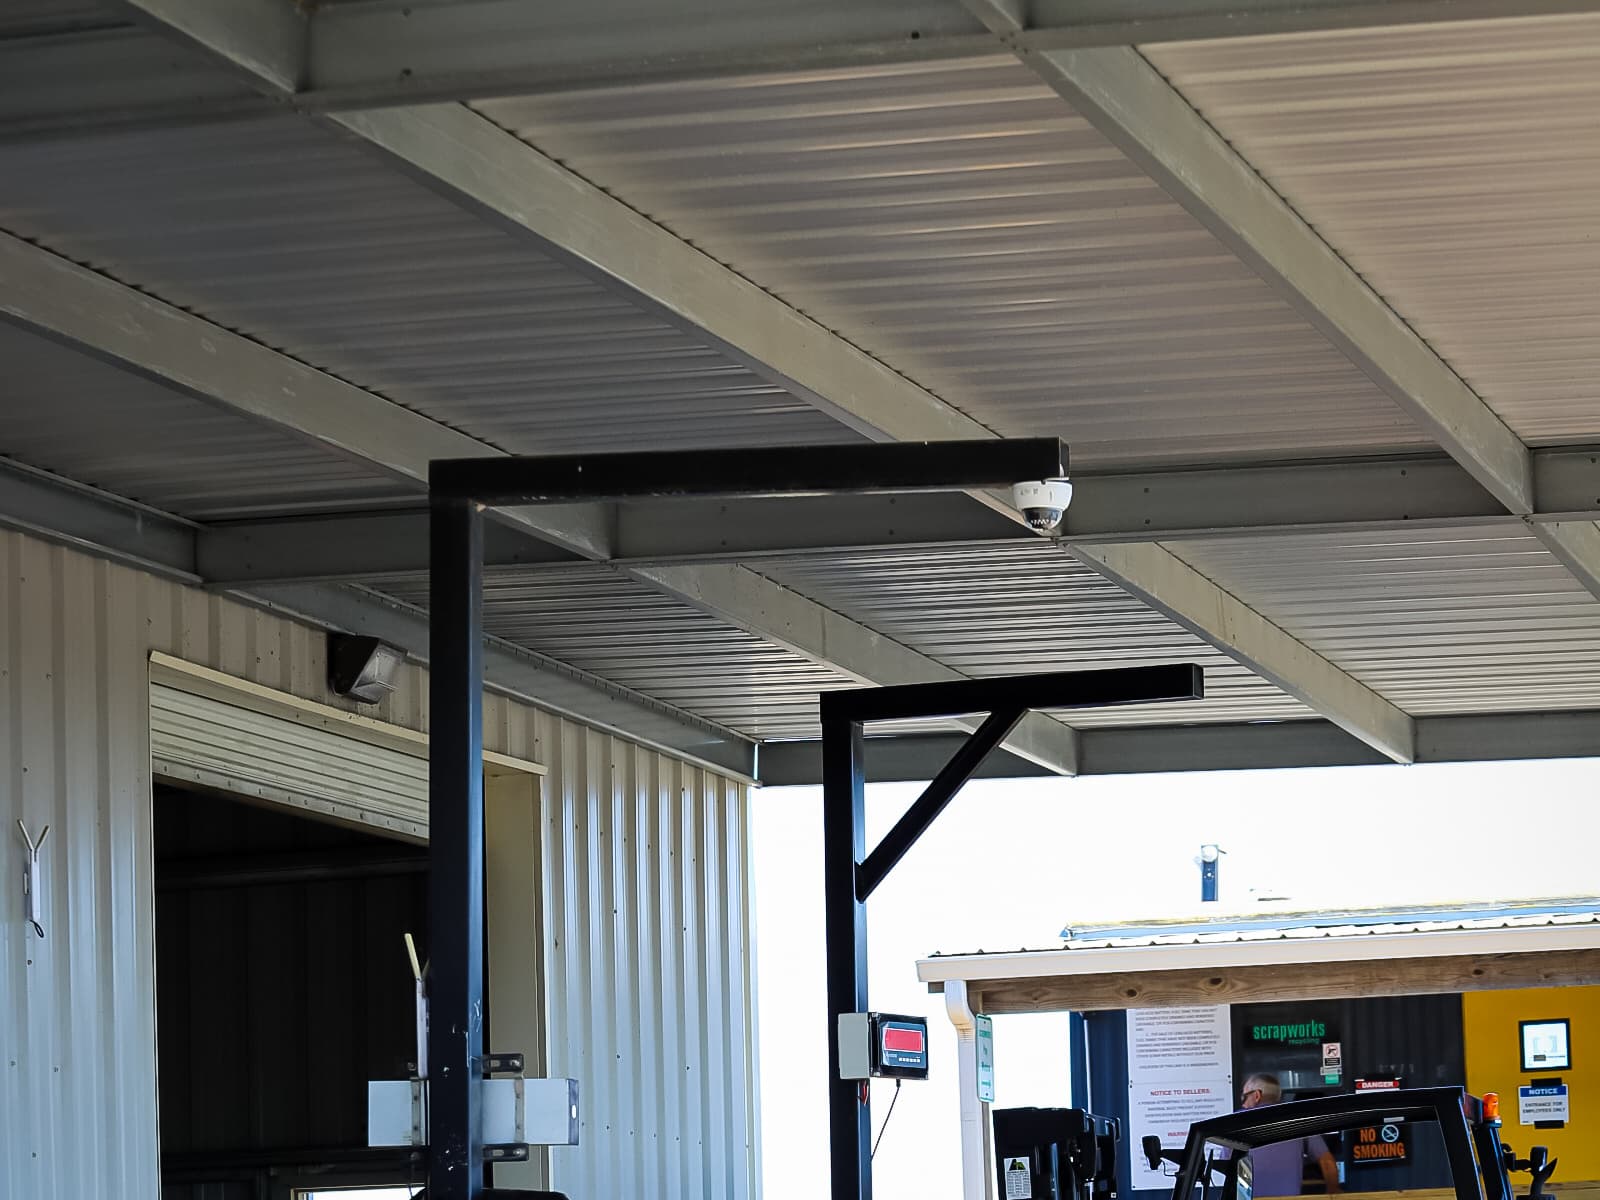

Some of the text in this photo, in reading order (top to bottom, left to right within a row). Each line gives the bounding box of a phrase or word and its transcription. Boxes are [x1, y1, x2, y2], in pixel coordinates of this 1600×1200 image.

[1253, 1019, 1326, 1042] scrapworks
[1361, 1081, 1394, 1089] DANGER
[1528, 1087, 1558, 1096] NOTICE
[1360, 1127, 1376, 1143] NO
[1353, 1142, 1405, 1159] SMOKING
